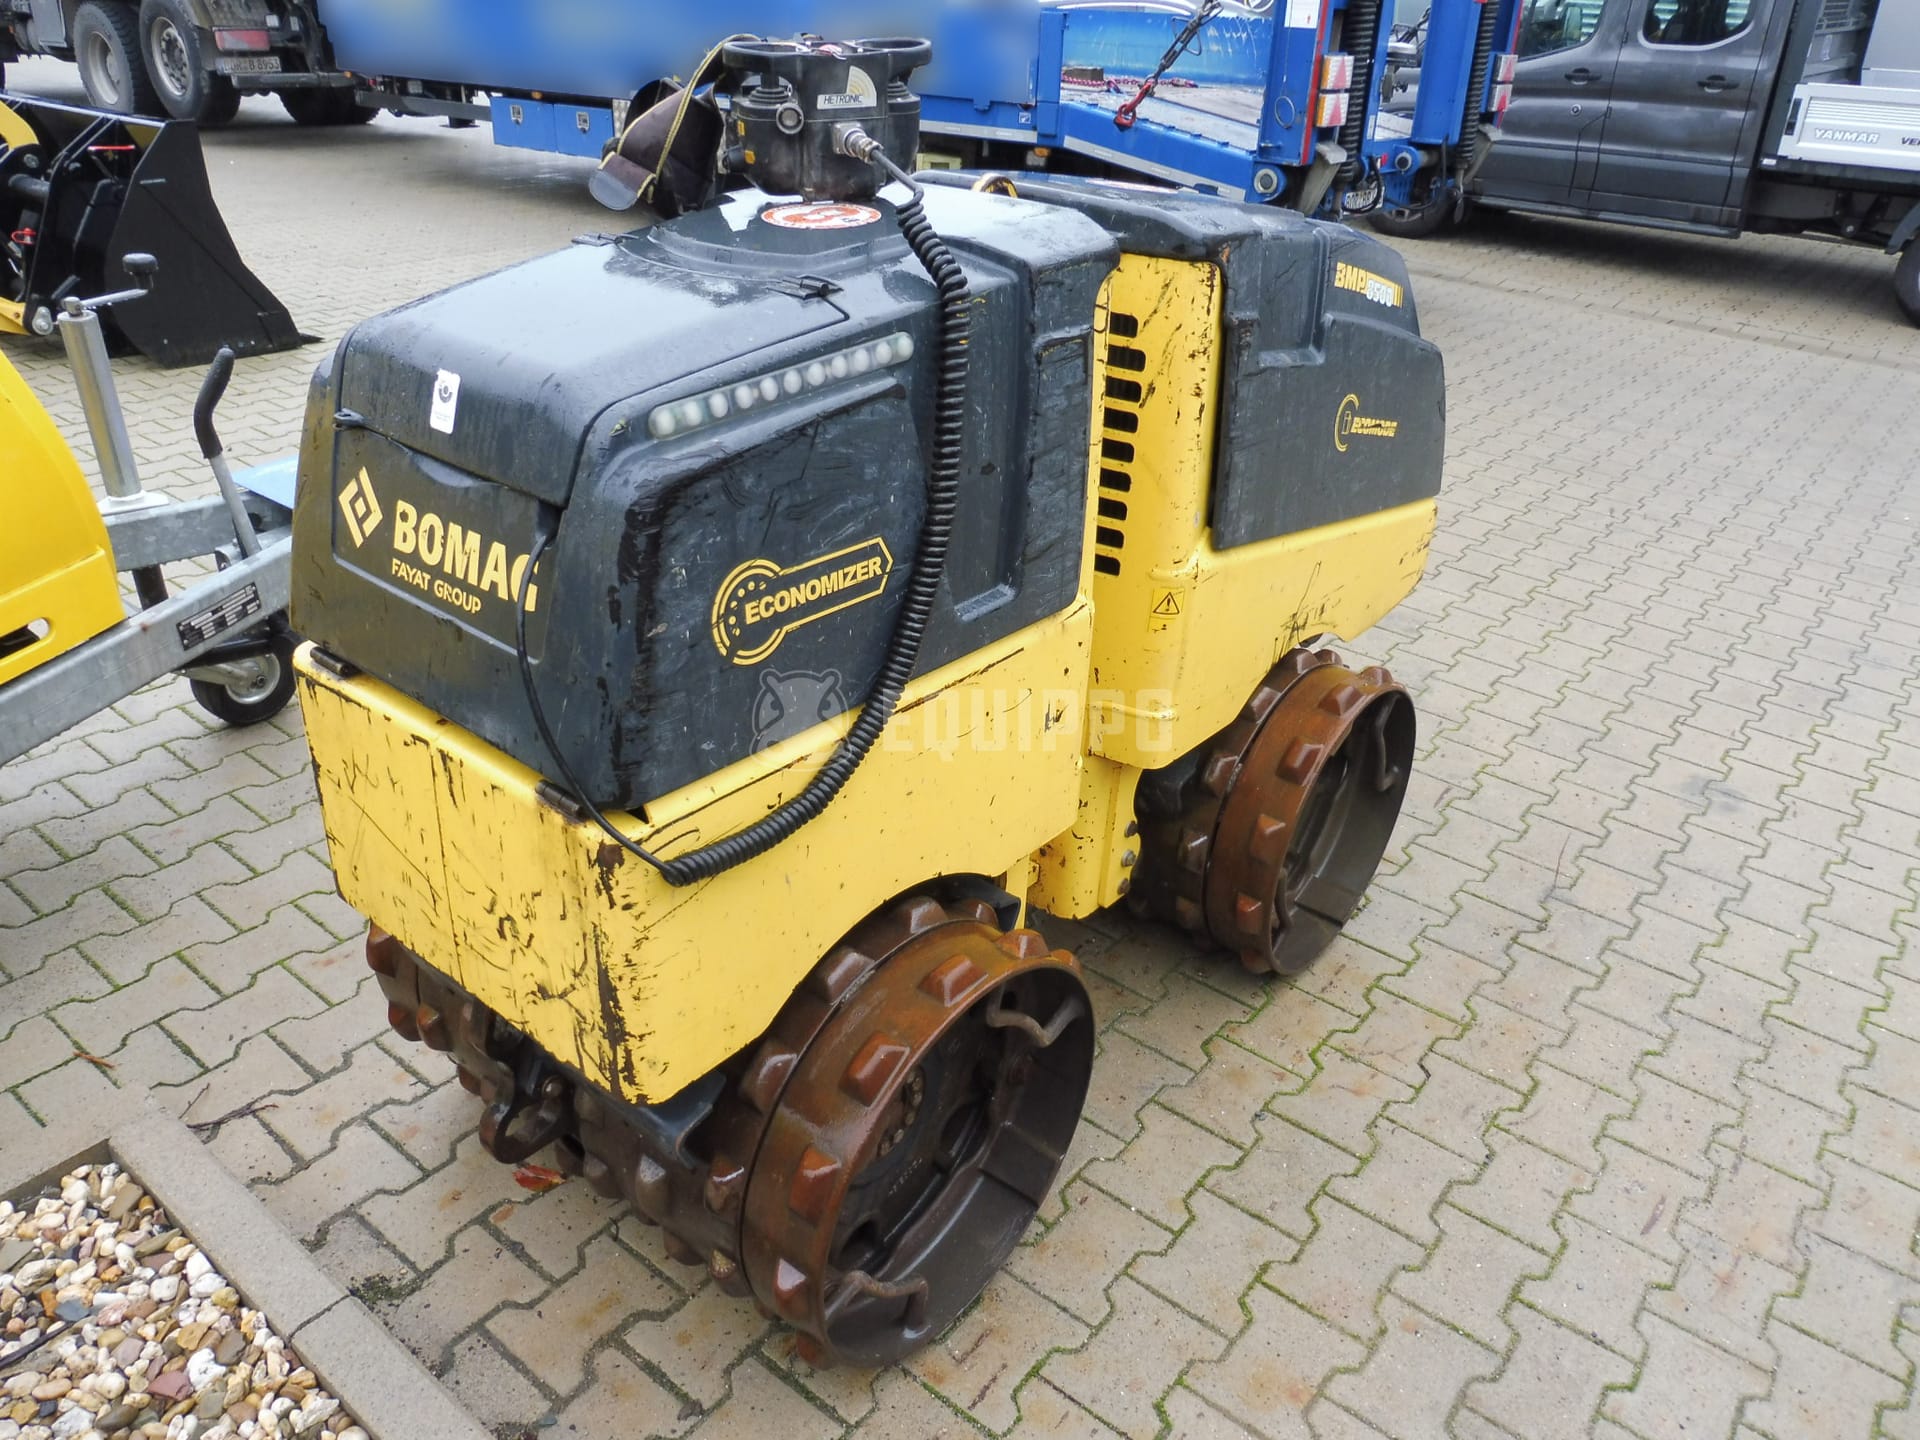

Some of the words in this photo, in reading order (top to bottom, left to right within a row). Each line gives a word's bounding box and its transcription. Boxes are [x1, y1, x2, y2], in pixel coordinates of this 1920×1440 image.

[823, 95, 863, 105] HETRONIC
[1814, 127, 1880, 144] YANMAR
[1334, 261, 1367, 294] BMP
[1366, 279, 1394, 308] 8500
[391, 557, 432, 591] FAYAT
[433, 578, 483, 615] GROUP
[744, 555, 883, 625] ECONOMIZER
